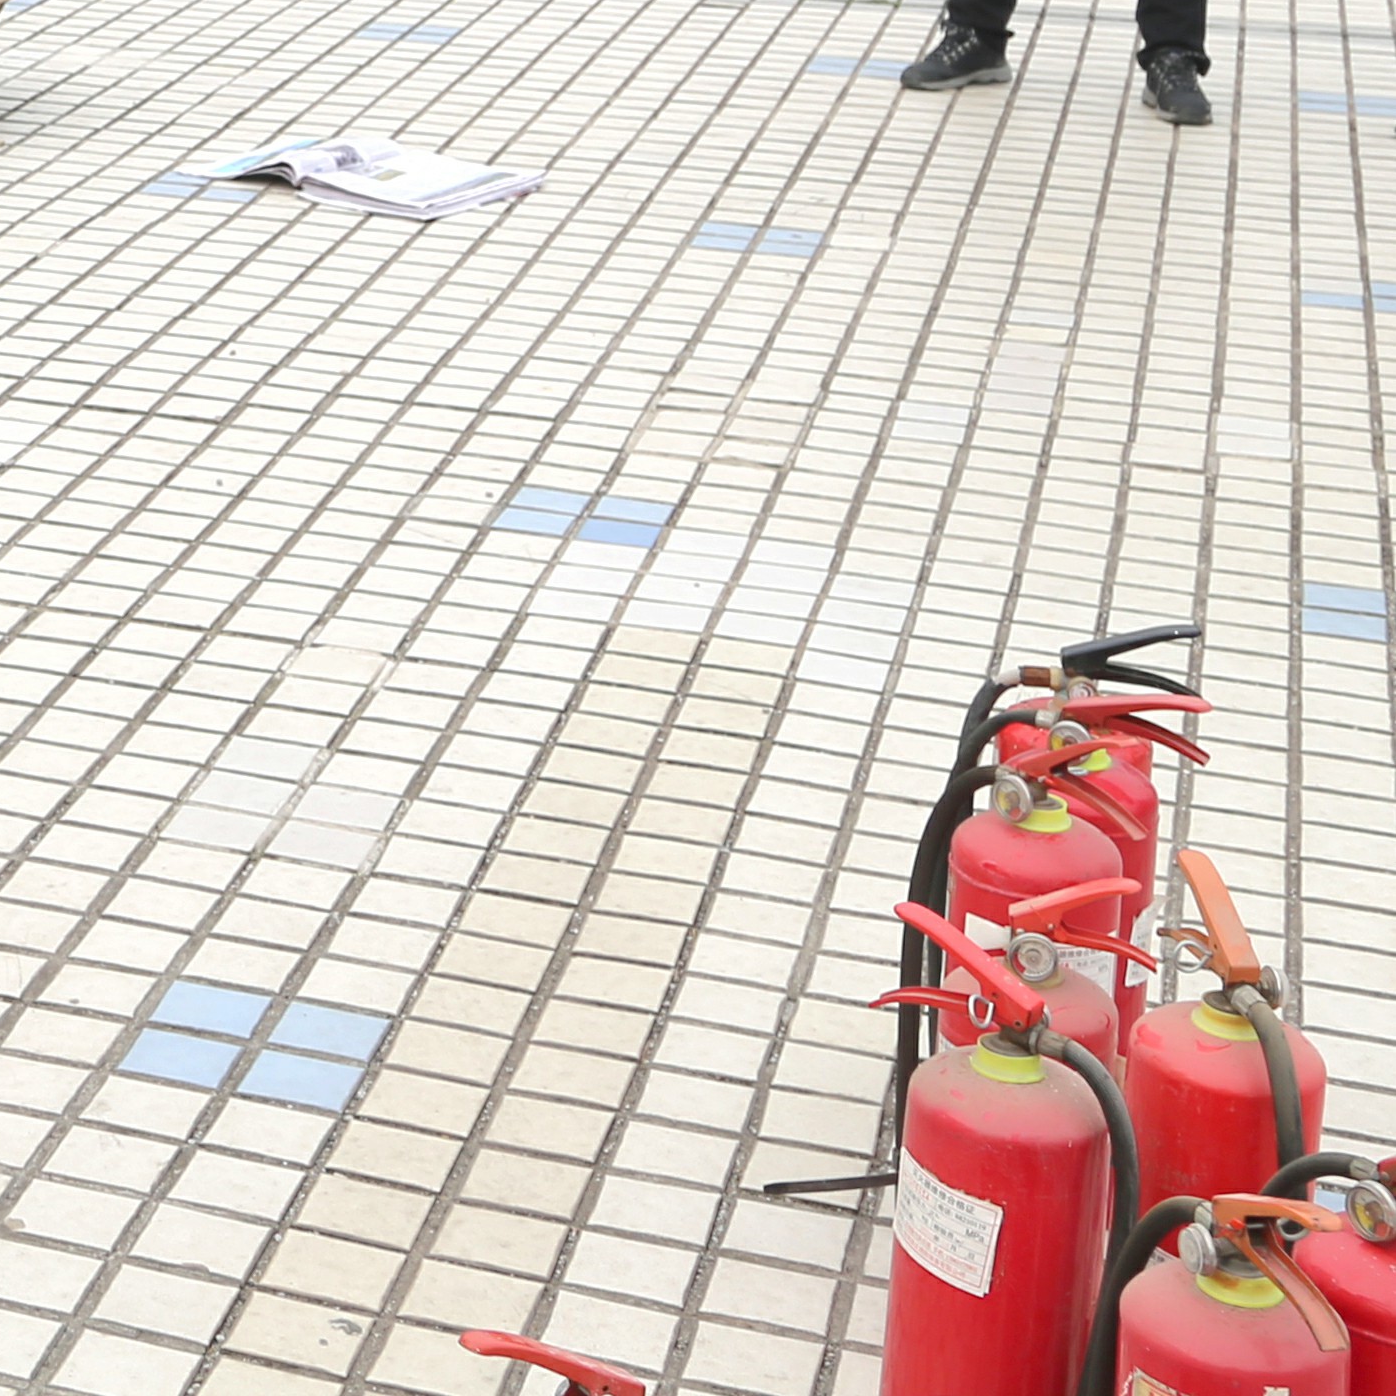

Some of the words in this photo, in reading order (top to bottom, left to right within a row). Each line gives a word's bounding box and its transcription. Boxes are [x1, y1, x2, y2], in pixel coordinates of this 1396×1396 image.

[912, 1167, 975, 1215] 灭火器维修合格证
[964, 1228, 985, 1243] MPa
